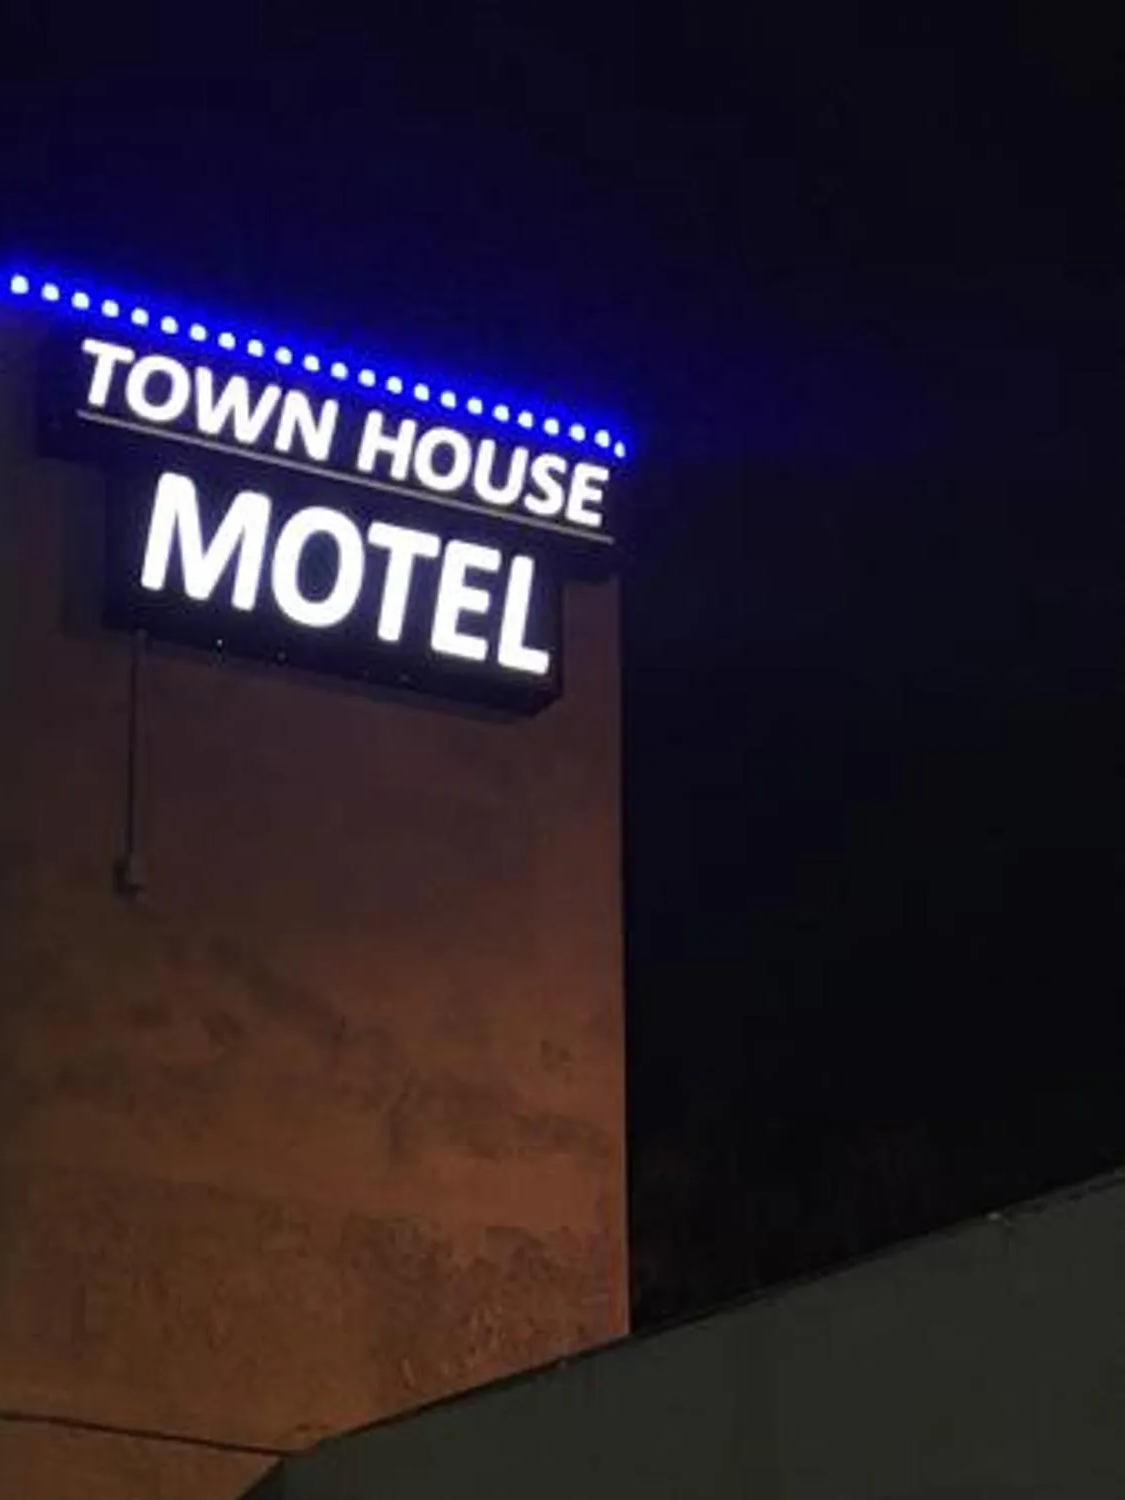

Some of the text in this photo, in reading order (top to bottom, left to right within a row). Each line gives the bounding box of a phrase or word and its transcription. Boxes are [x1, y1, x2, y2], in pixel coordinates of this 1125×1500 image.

[81, 338, 610, 528] TOWN HOUSE
[140, 471, 550, 675] MOTEL
